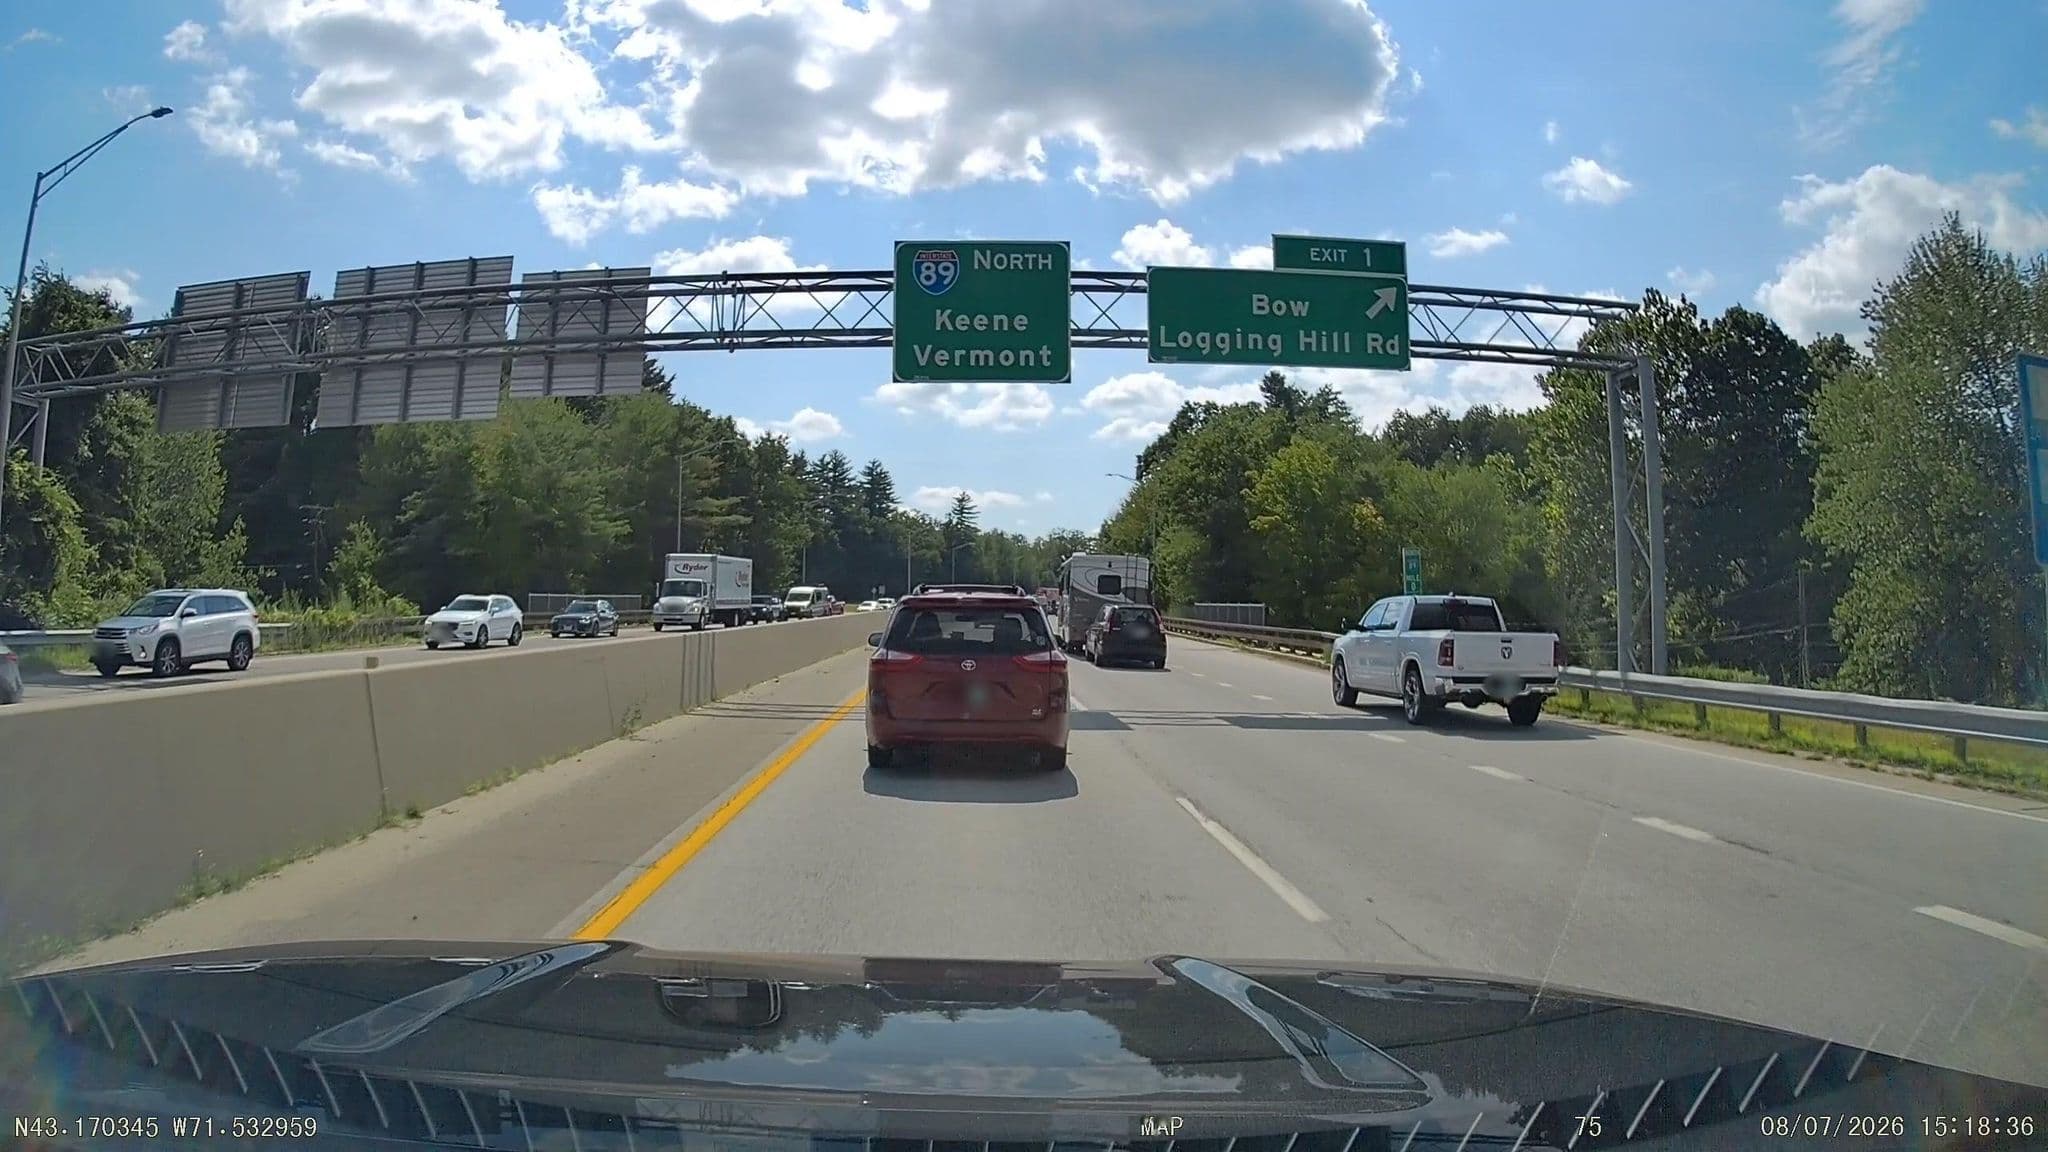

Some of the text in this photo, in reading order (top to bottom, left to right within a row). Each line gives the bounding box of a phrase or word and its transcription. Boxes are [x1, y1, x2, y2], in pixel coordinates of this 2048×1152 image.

[973, 249, 1052, 271] NORTH
[1310, 248, 1371, 267] EXIT 1
[919, 262, 955, 286] 89
[1252, 294, 1310, 317] Bow
[935, 309, 1029, 331] Keene
[1159, 326, 1400, 358] Logging Hill Rd
[913, 344, 1052, 367] Vermont
[682, 563, 708, 572] Ryder
